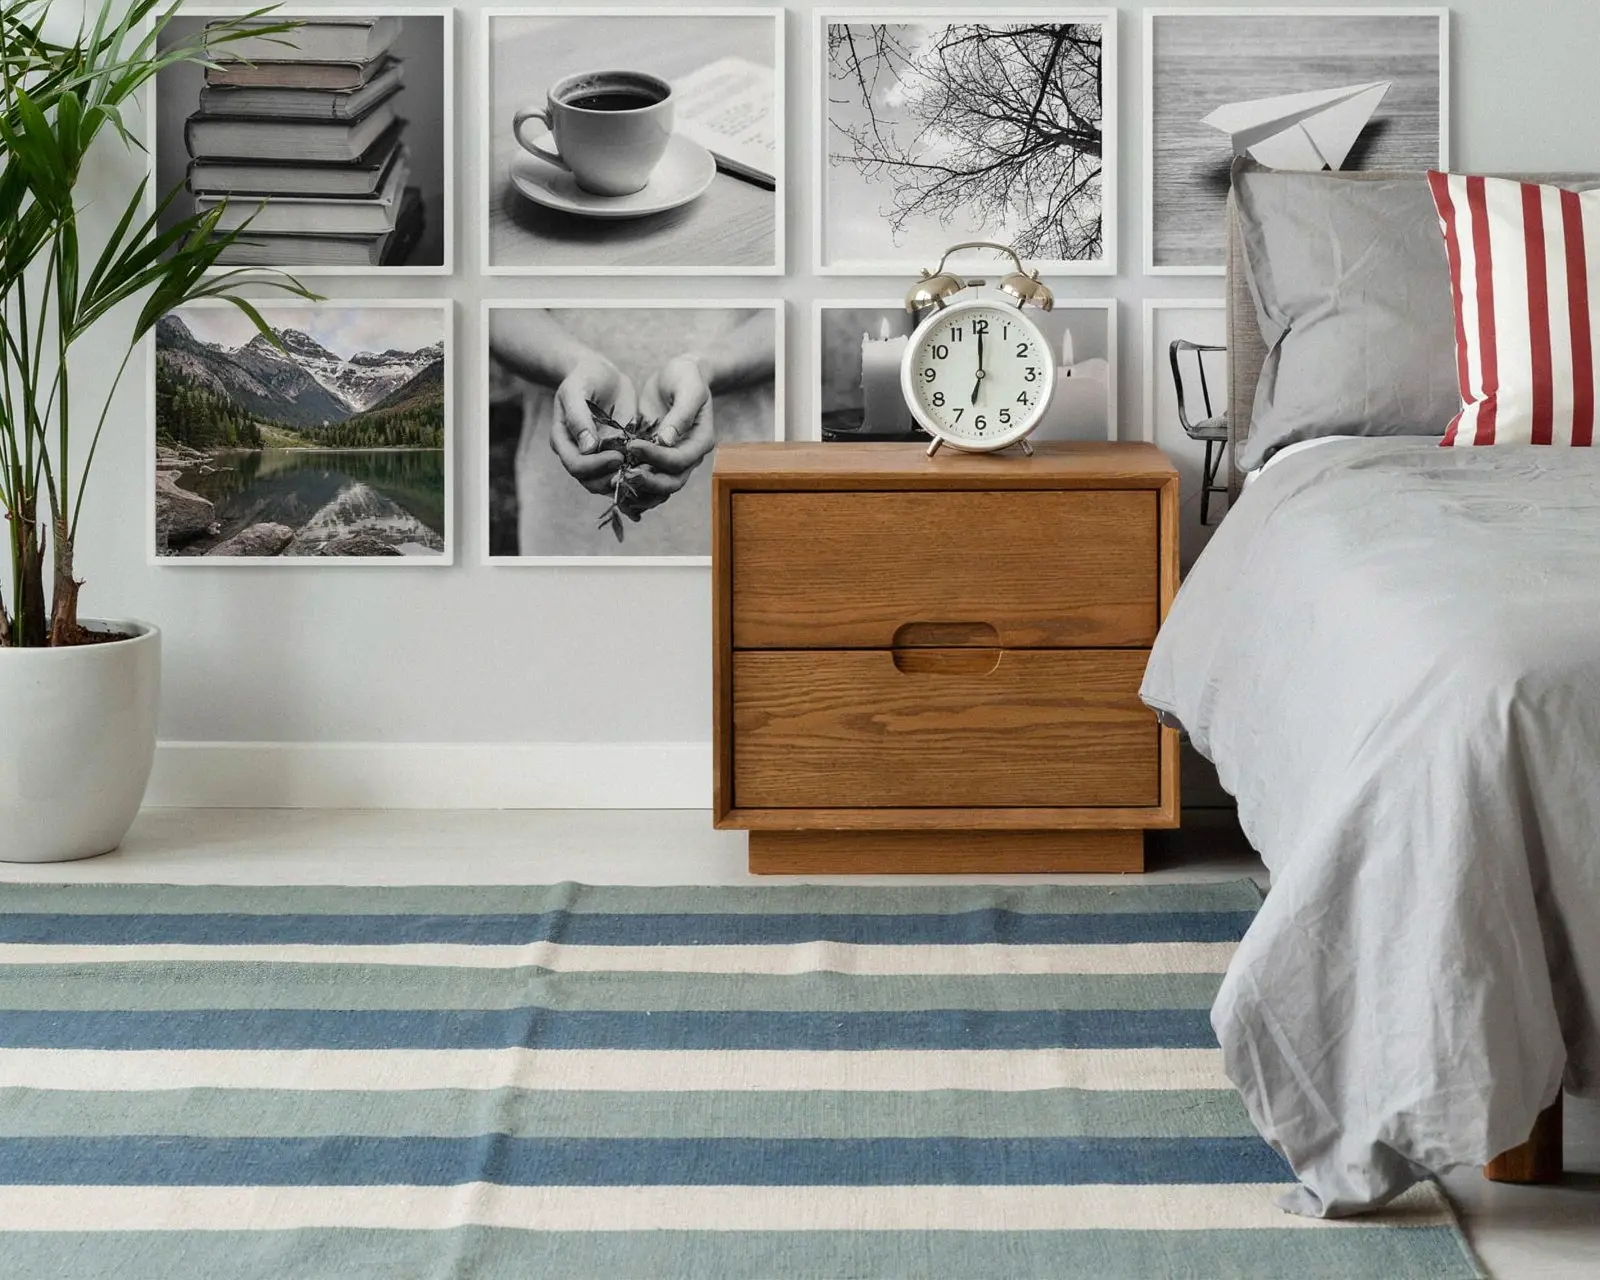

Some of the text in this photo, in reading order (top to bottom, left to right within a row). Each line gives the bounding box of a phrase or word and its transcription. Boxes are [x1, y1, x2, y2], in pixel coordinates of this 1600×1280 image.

[951, 327, 963, 342] 11
[972, 320, 989, 335] 12
[932, 345, 949, 360] 10
[1016, 343, 1029, 358] 2
[924, 368, 936, 383] 9
[1024, 367, 1036, 382] 3
[932, 392, 945, 407] 8
[1017, 391, 1029, 406] 4
[953, 408, 965, 423] 7
[974, 415, 987, 430] 6
[999, 408, 1011, 424] 5
